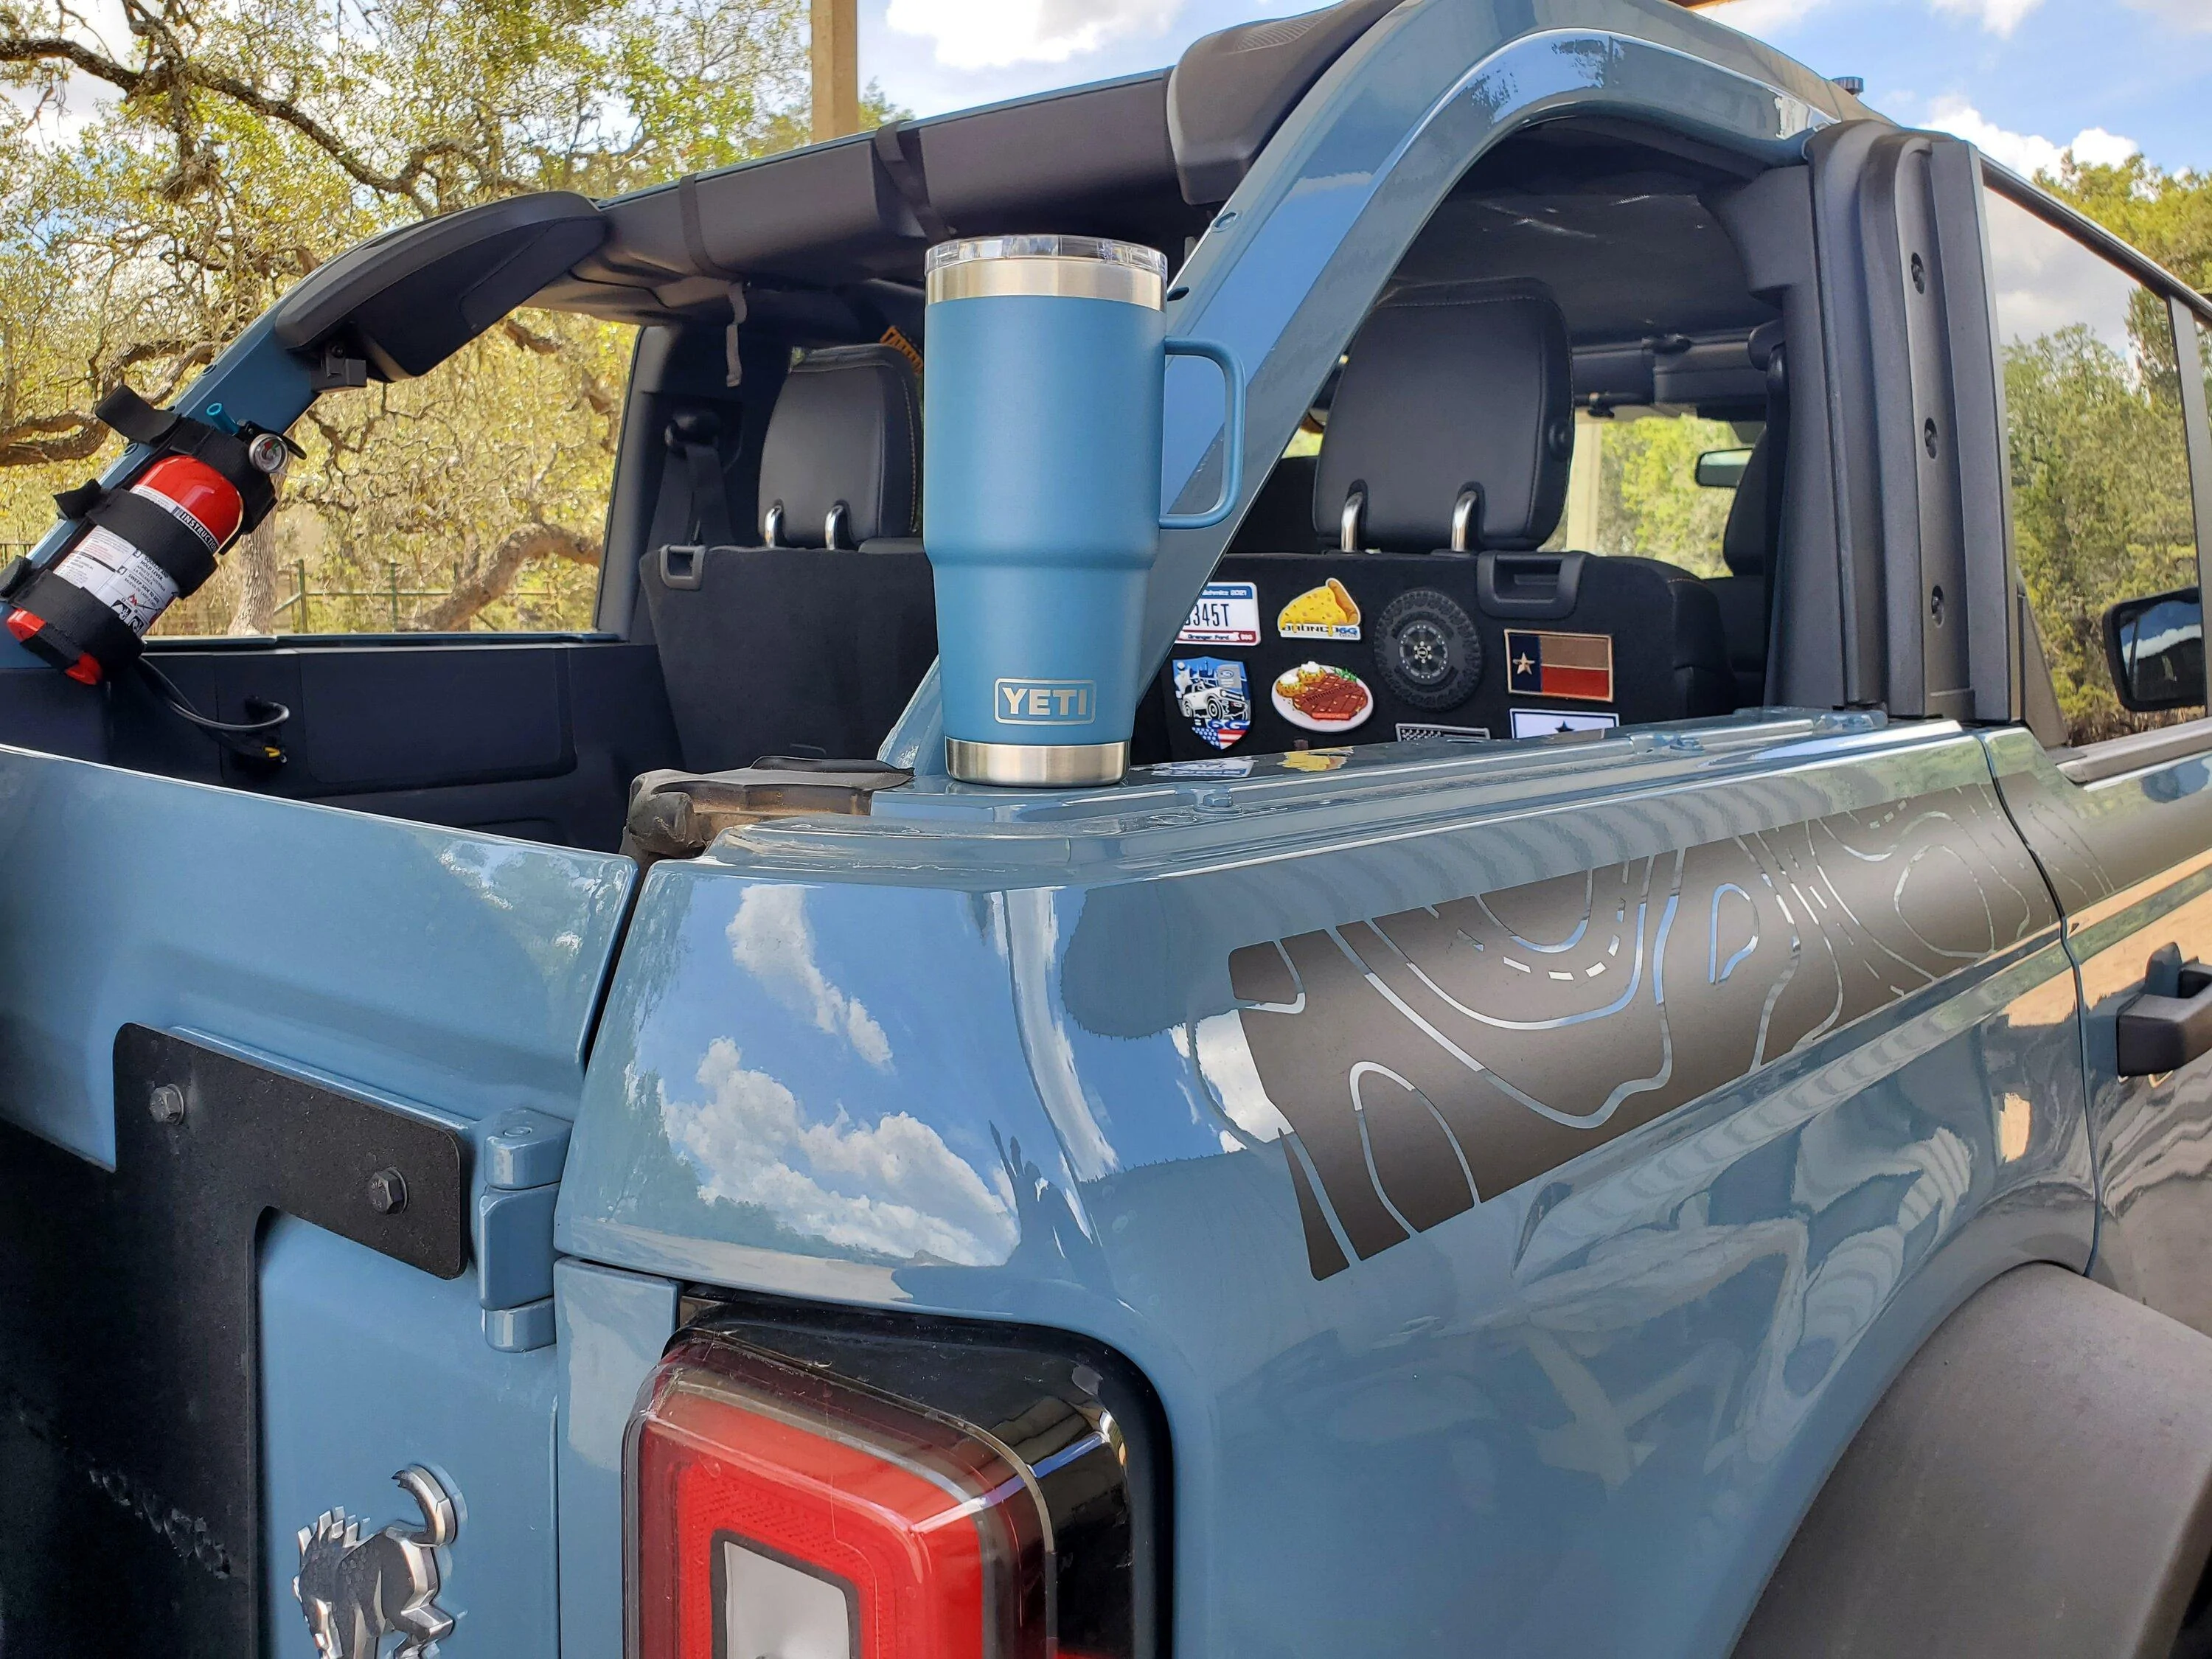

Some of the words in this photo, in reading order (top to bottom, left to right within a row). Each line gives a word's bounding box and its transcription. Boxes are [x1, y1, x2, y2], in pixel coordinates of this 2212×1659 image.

[128, 573, 142, 586] SWEEP
[140, 560, 153, 571] HOLD
[150, 569, 164, 581] LEVER
[1001, 687, 1088, 716] YETI
